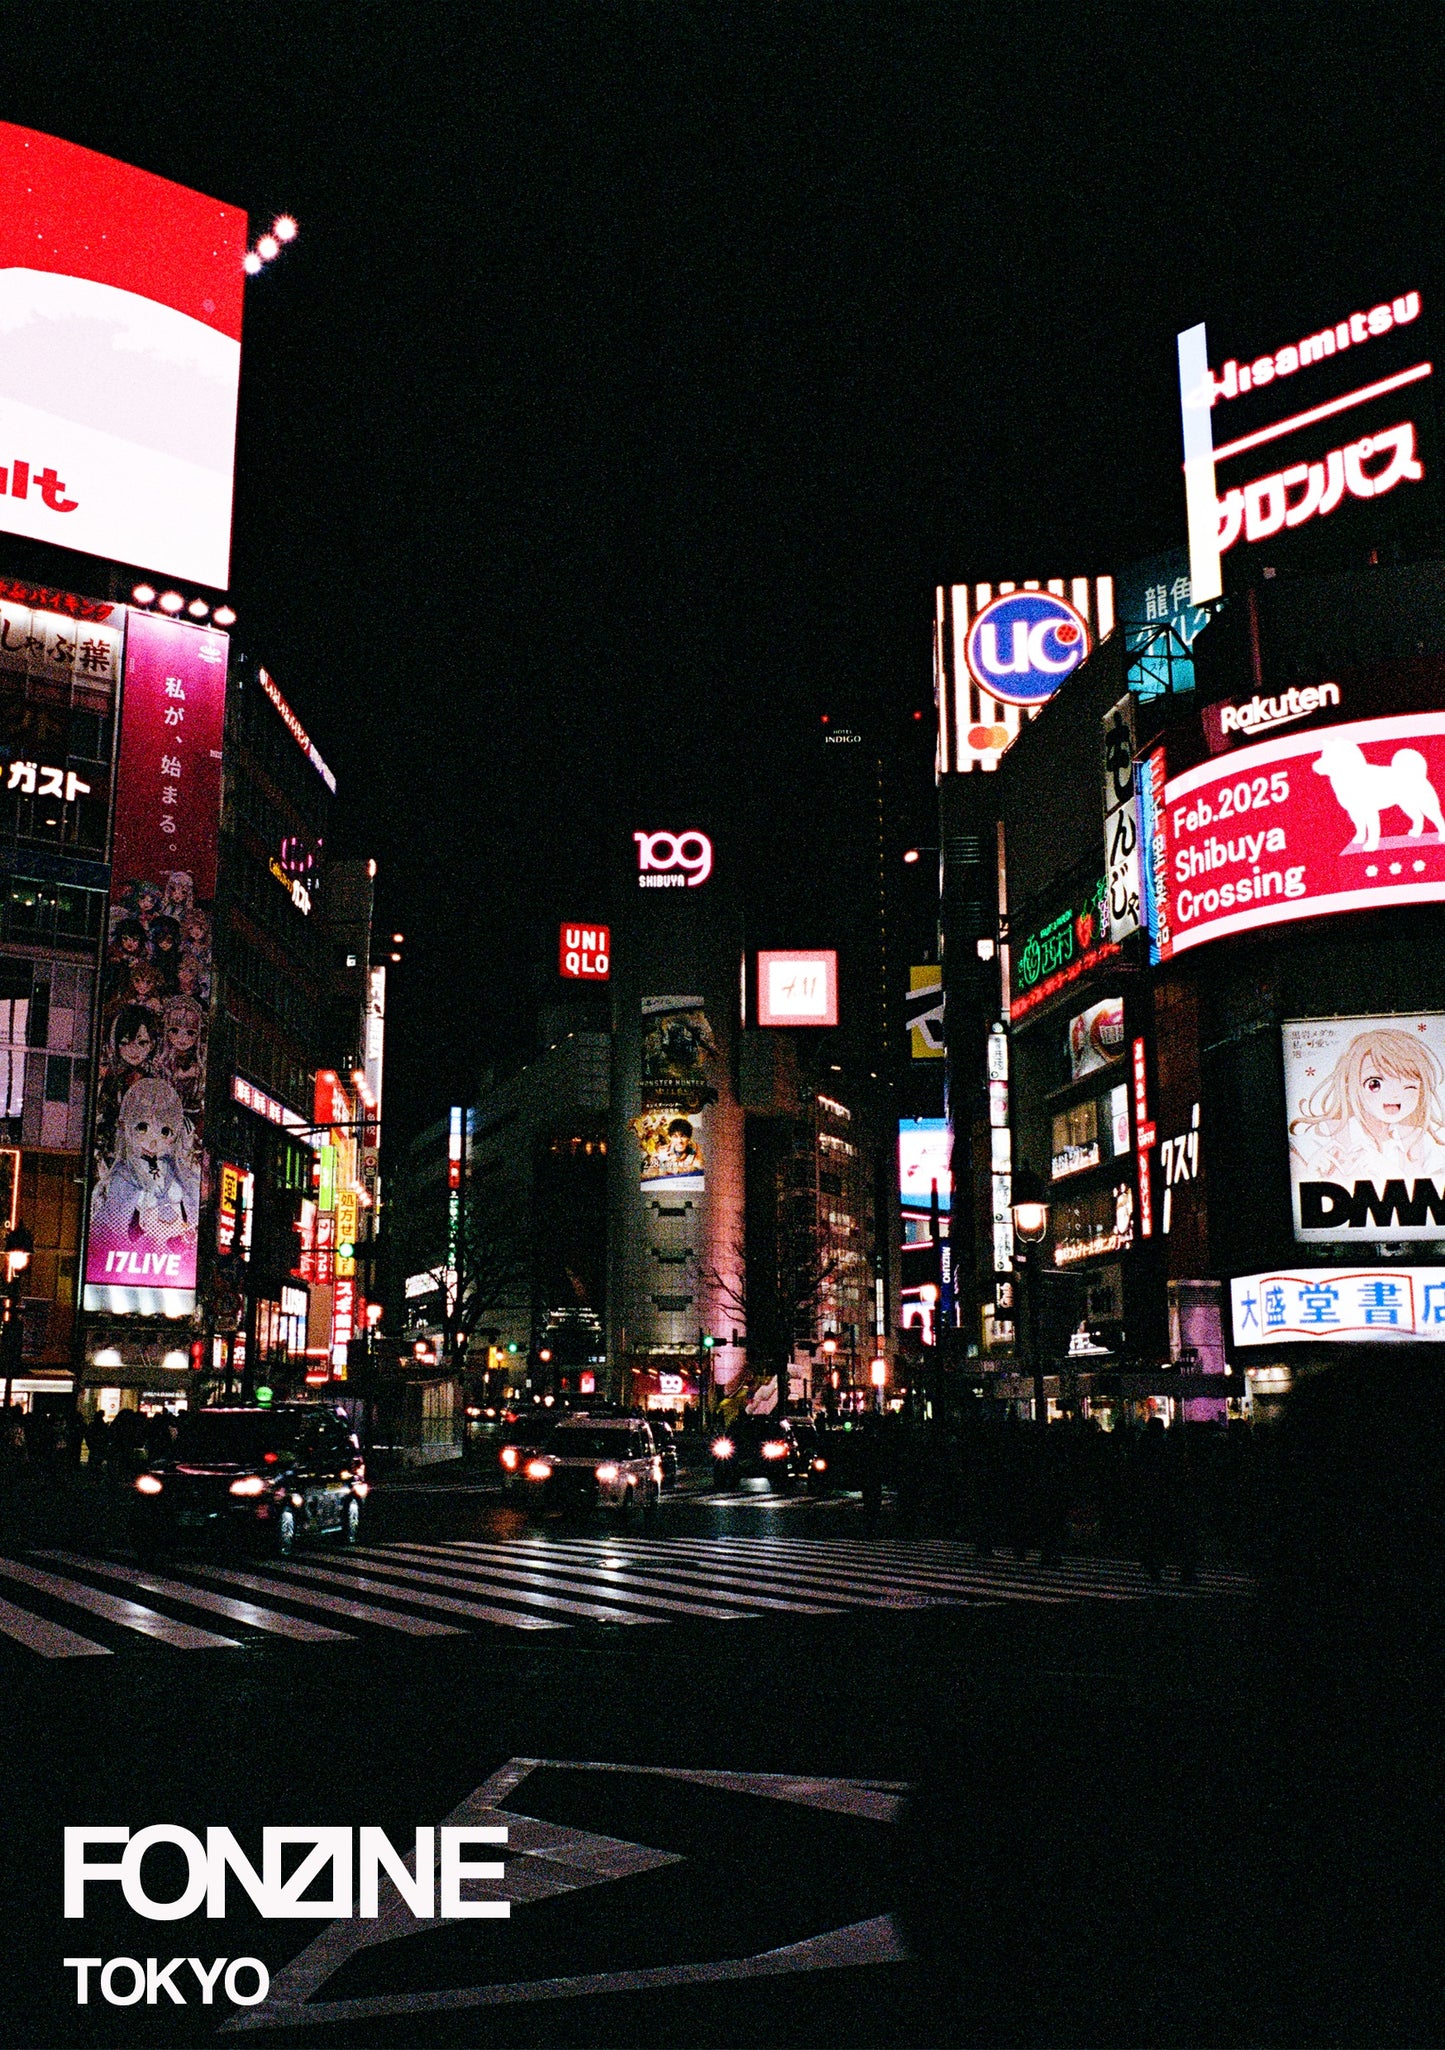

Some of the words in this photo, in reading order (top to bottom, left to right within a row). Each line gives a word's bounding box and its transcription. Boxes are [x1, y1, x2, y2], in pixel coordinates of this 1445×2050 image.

[1186, 291, 1420, 408] Hisamitsu
[1220, 682, 1339, 734] Rakuten
[158, 677, 186, 853] 私が、始まる。
[825, 735, 862, 744] INDIGO
[7, 761, 91, 802] ガスト
[1173, 771, 1290, 838] Feb.2025
[1105, 709, 1140, 928] もんじゃ
[633, 831, 712, 887] 109
[638, 874, 685, 888] SHIBUYA
[1175, 827, 1287, 882] Shibuya
[1177, 864, 1306, 923] Crossing
[565, 928, 606, 949] UNI
[565, 950, 609, 975] QLO
